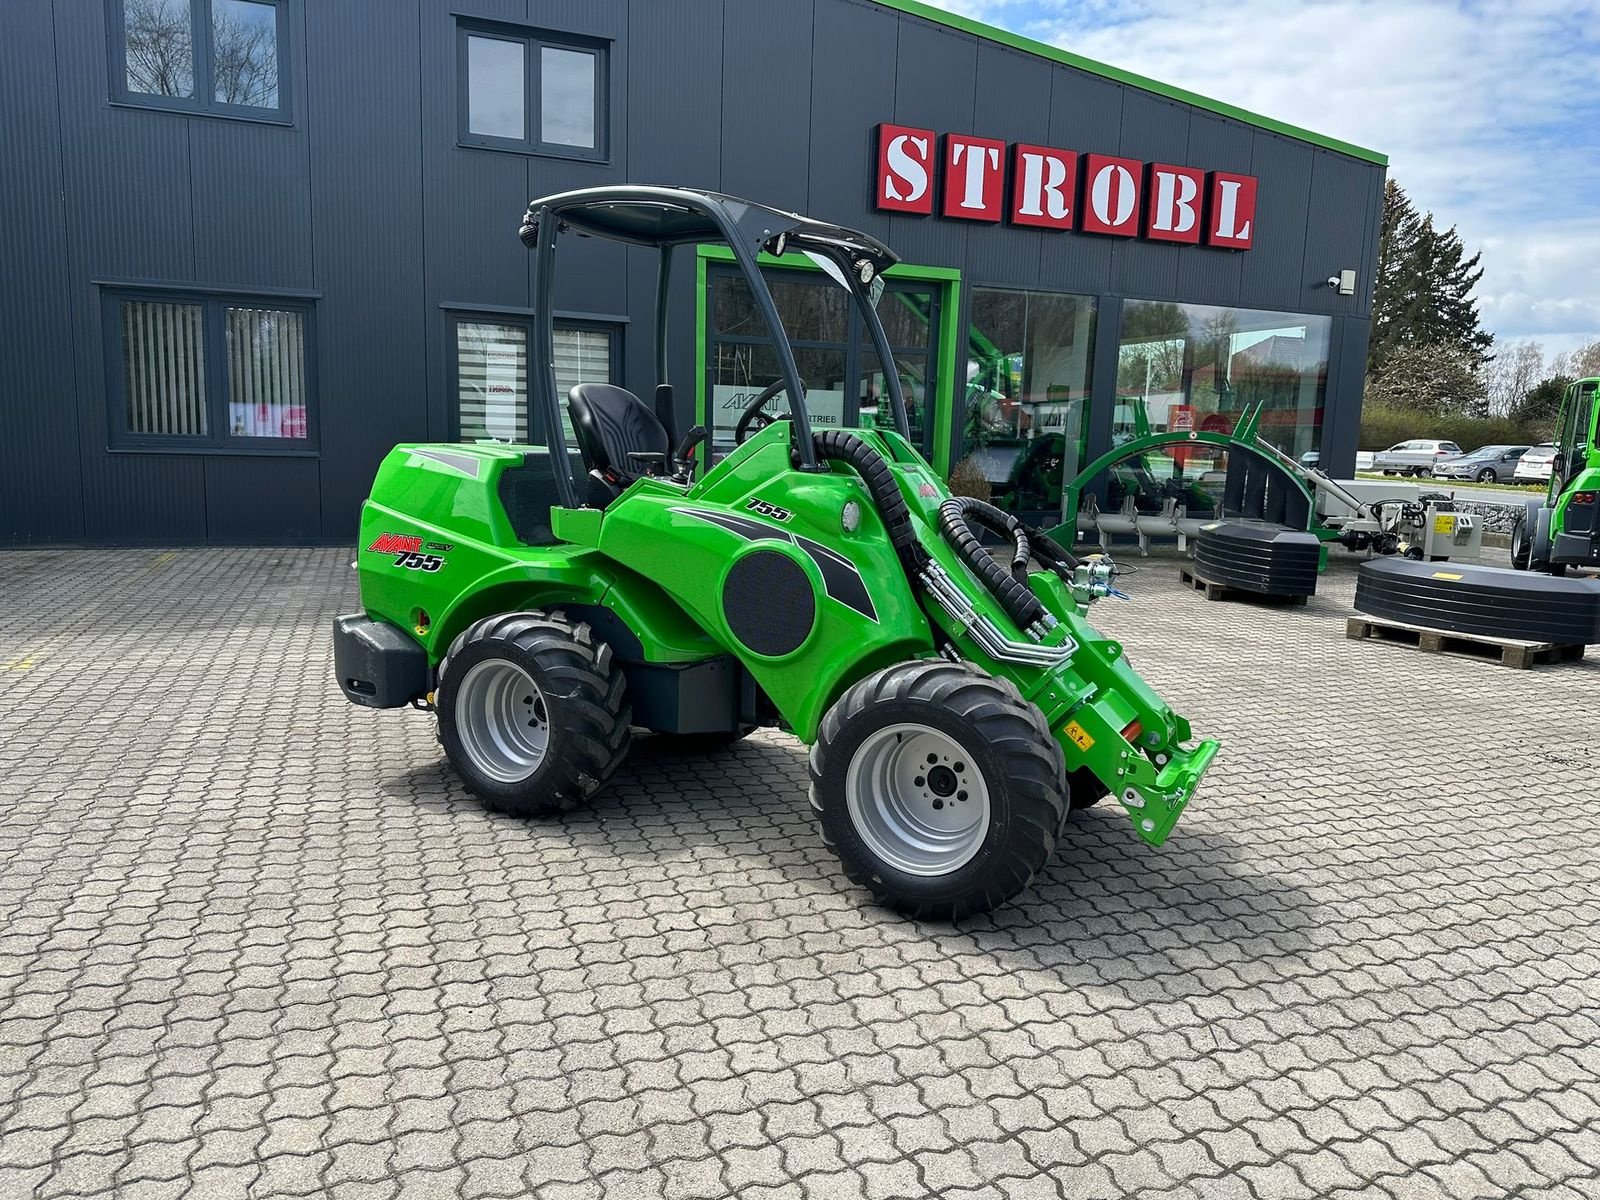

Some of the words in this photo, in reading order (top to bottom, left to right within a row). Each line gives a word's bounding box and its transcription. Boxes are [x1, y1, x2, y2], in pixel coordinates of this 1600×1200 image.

[885, 134, 1251, 241] STROBL
[722, 392, 781, 411] AVNT
[808, 414, 837, 424] RTRIEB
[367, 532, 424, 555] AVANT
